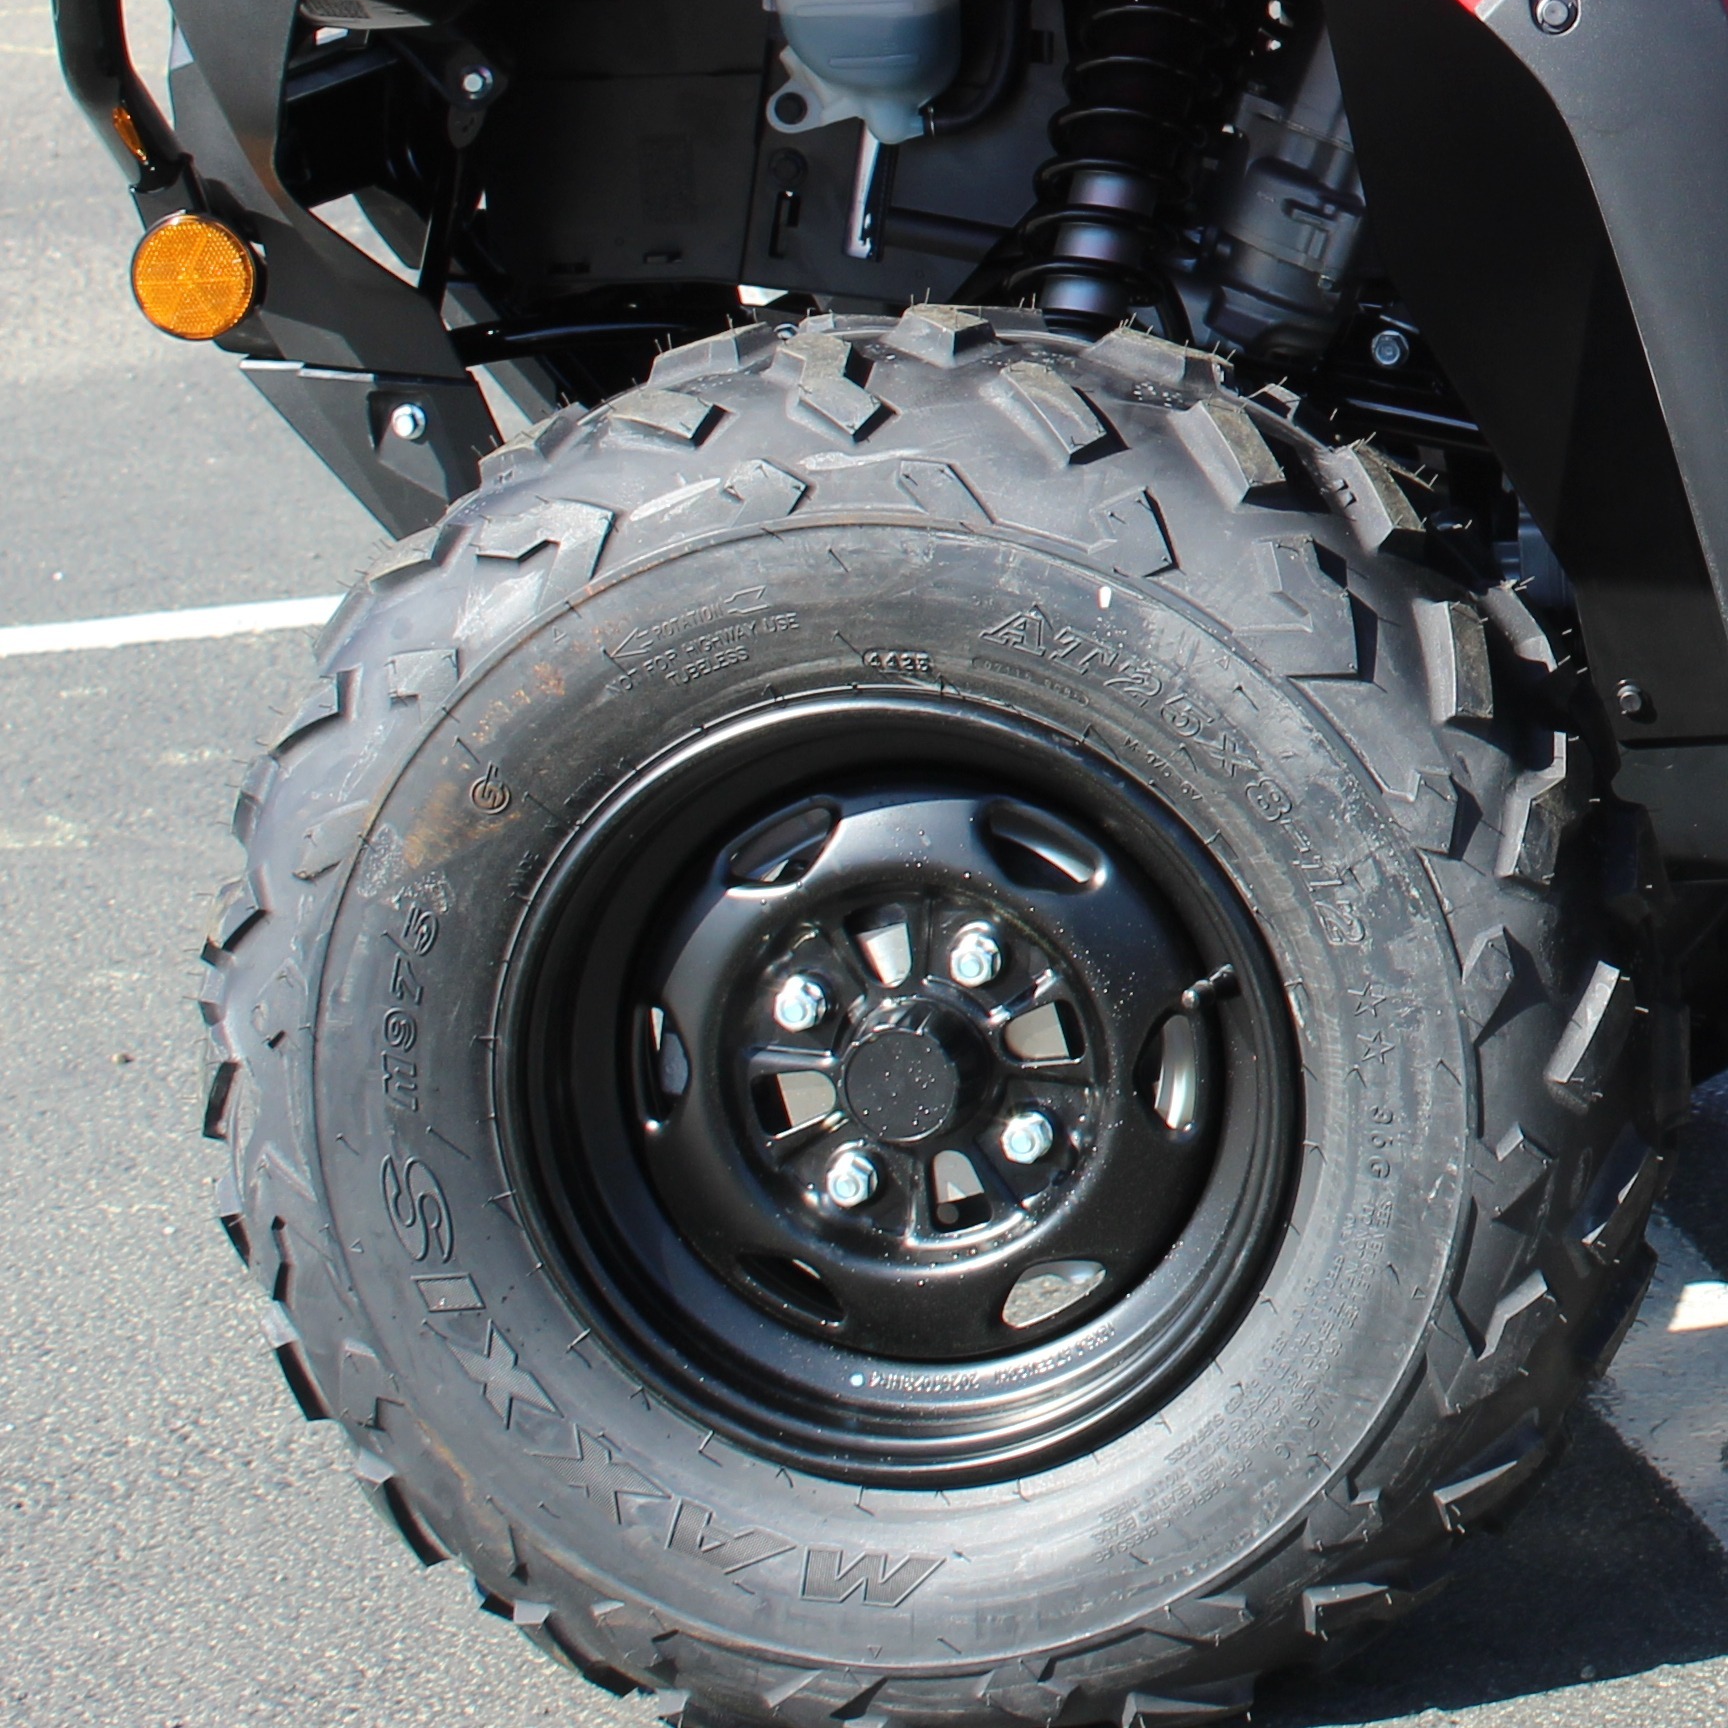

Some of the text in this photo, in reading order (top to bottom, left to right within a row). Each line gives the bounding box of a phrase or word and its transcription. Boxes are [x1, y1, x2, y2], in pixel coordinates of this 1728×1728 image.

[604, 608, 801, 701] NOT FOR HIGHWAY USE
[650, 596, 725, 646] ROTATION
[663, 638, 750, 693] TUBELESS
[380, 905, 441, 1113] M975
[380, 1153, 948, 1610] MAXXIS
[1270, 1383, 1341, 1463] WARNING
